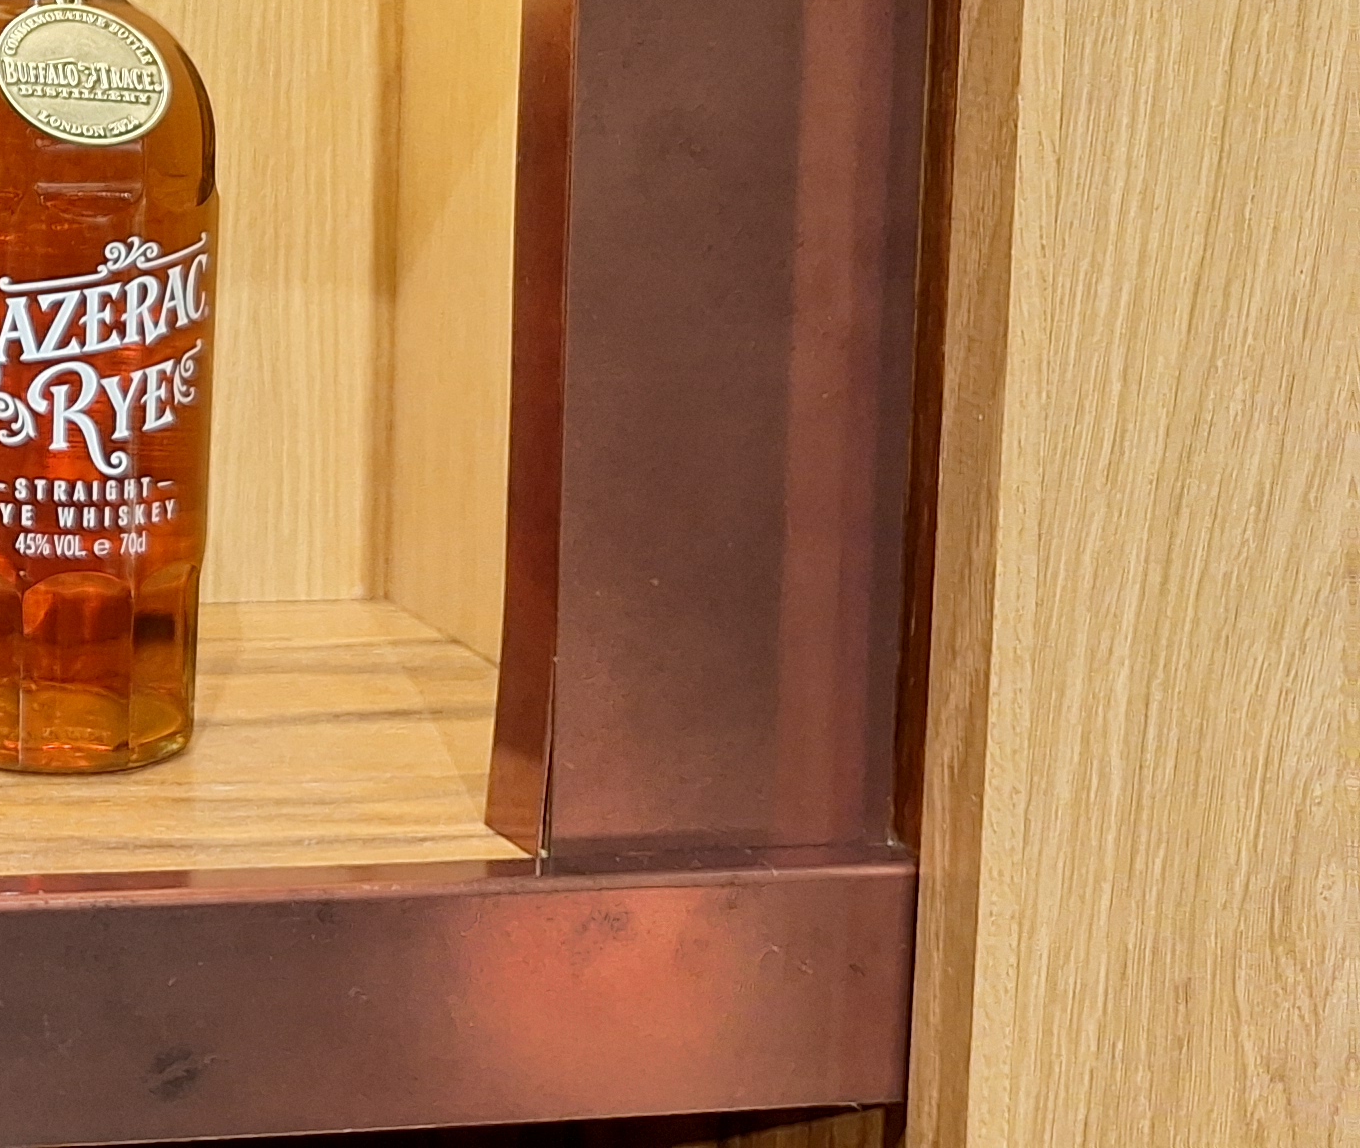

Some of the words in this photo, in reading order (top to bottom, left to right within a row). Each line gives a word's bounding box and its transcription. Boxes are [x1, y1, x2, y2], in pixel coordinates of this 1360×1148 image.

[3, 9, 106, 56] COMMEMORATIVE
[108, 26, 153, 65] BOTTLE
[1, 58, 79, 87] BUFFALO
[95, 62, 157, 91] TRACE
[18, 85, 151, 104] DISTILLERY
[37, 109, 106, 137] LONDON
[26, 360, 178, 476] RYE
[14, 477, 152, 502] STRAIGHT
[58, 499, 176, 529] WHISKEY
[15, 533, 50, 558] 45%
[54, 535, 87, 558] VOL
